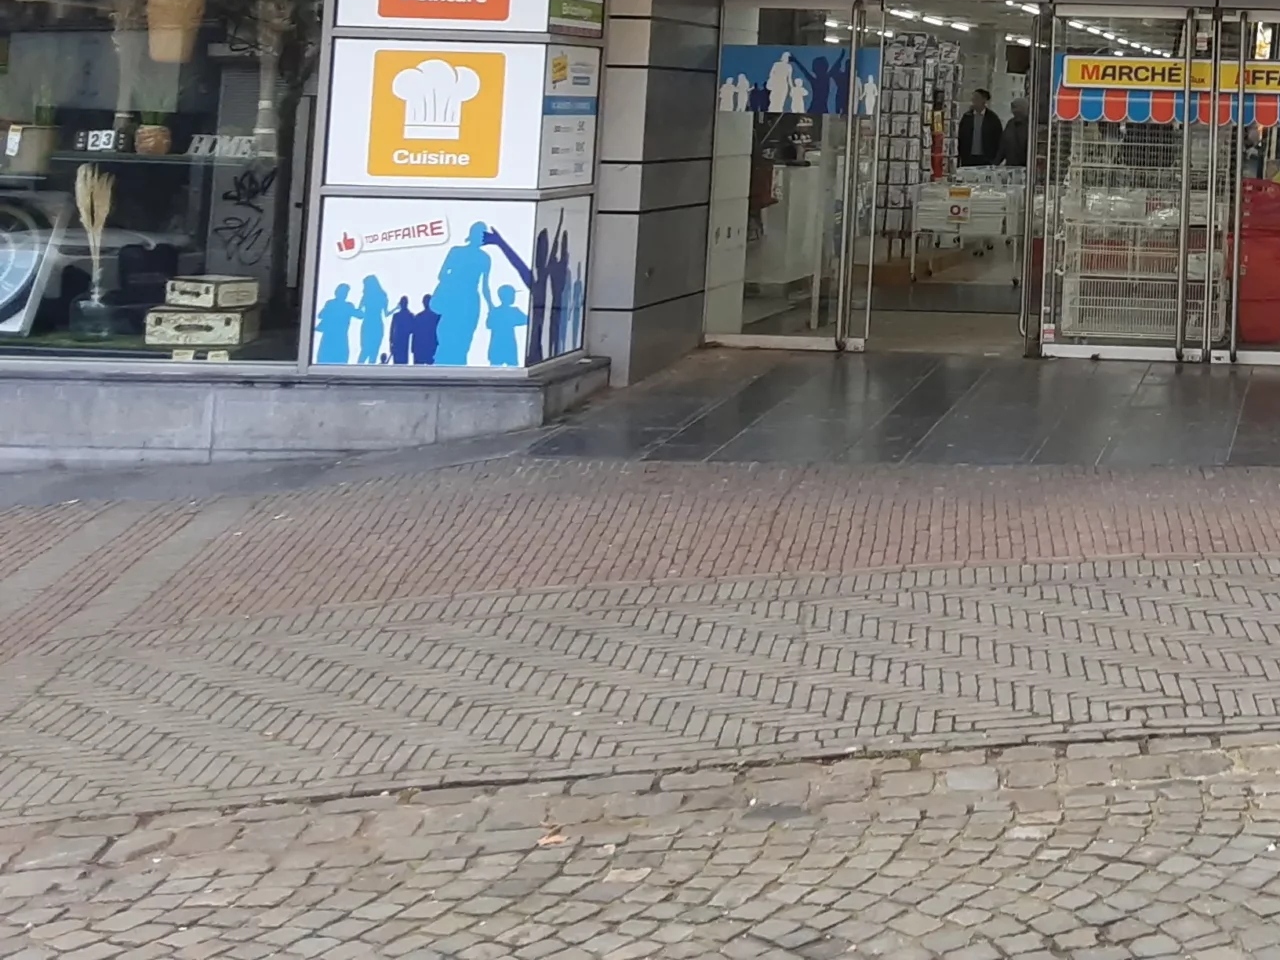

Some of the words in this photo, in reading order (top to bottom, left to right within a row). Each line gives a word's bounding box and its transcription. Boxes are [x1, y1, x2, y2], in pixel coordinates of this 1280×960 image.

[1081, 63, 1182, 83] MARCHÉ
[90, 133, 113, 147] 23
[393, 149, 470, 165] Cuisine
[365, 234, 379, 243] TOP
[381, 220, 444, 242] AFFAIRE
